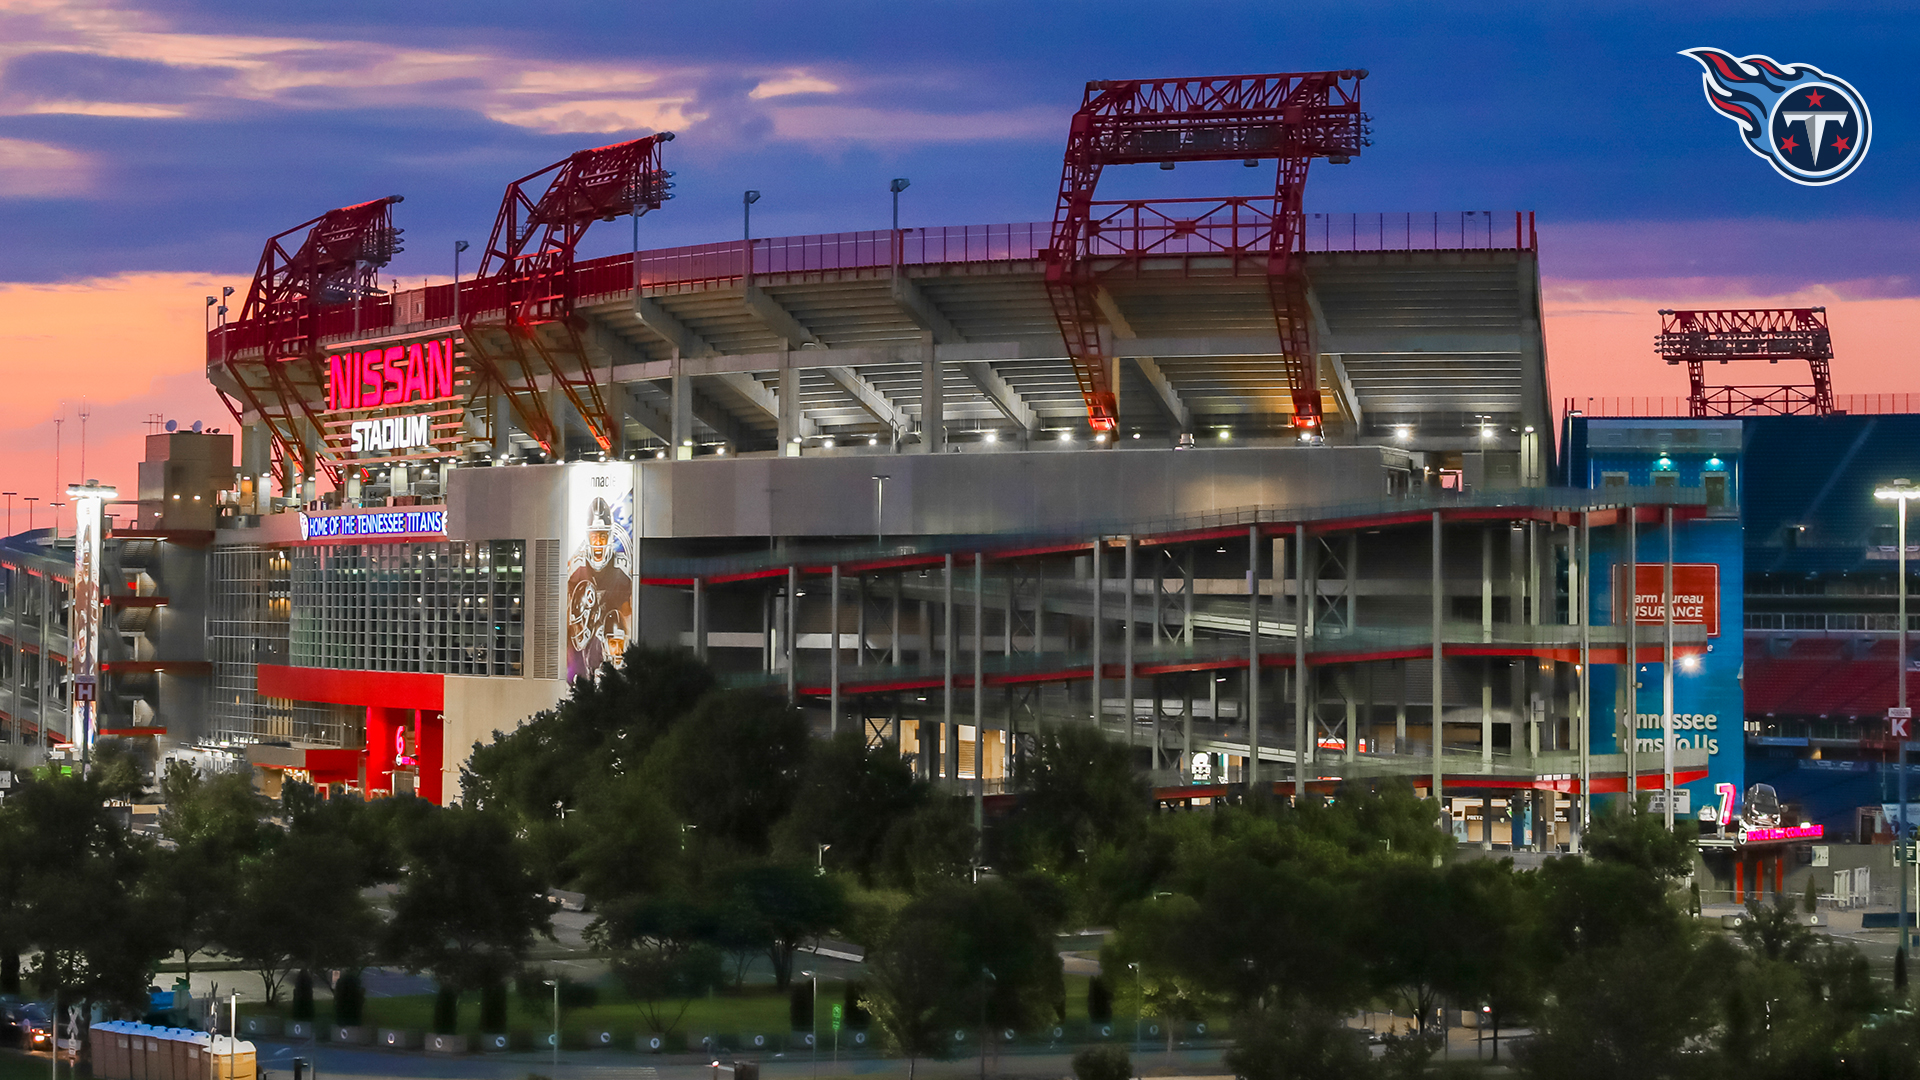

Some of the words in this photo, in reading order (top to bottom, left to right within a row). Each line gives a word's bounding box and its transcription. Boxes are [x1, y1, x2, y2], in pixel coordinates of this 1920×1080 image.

[329, 338, 454, 410] NISSAN
[351, 414, 429, 453] STADIUM
[309, 517, 328, 536] HOME
[329, 516, 340, 535] OF
[341, 515, 356, 534] THE
[357, 513, 405, 534] TENNESSEE
[406, 511, 442, 532] TITANS
[1634, 594, 1658, 604] arm
[1626, 605, 1704, 618] SURNCE
[78, 684, 93, 700] H
[1613, 708, 1718, 730] nnssee
[1891, 718, 1909, 737] K
[395, 725, 406, 755] 6
[1694, 734, 1719, 754] Us
[1714, 782, 1736, 826] 7
